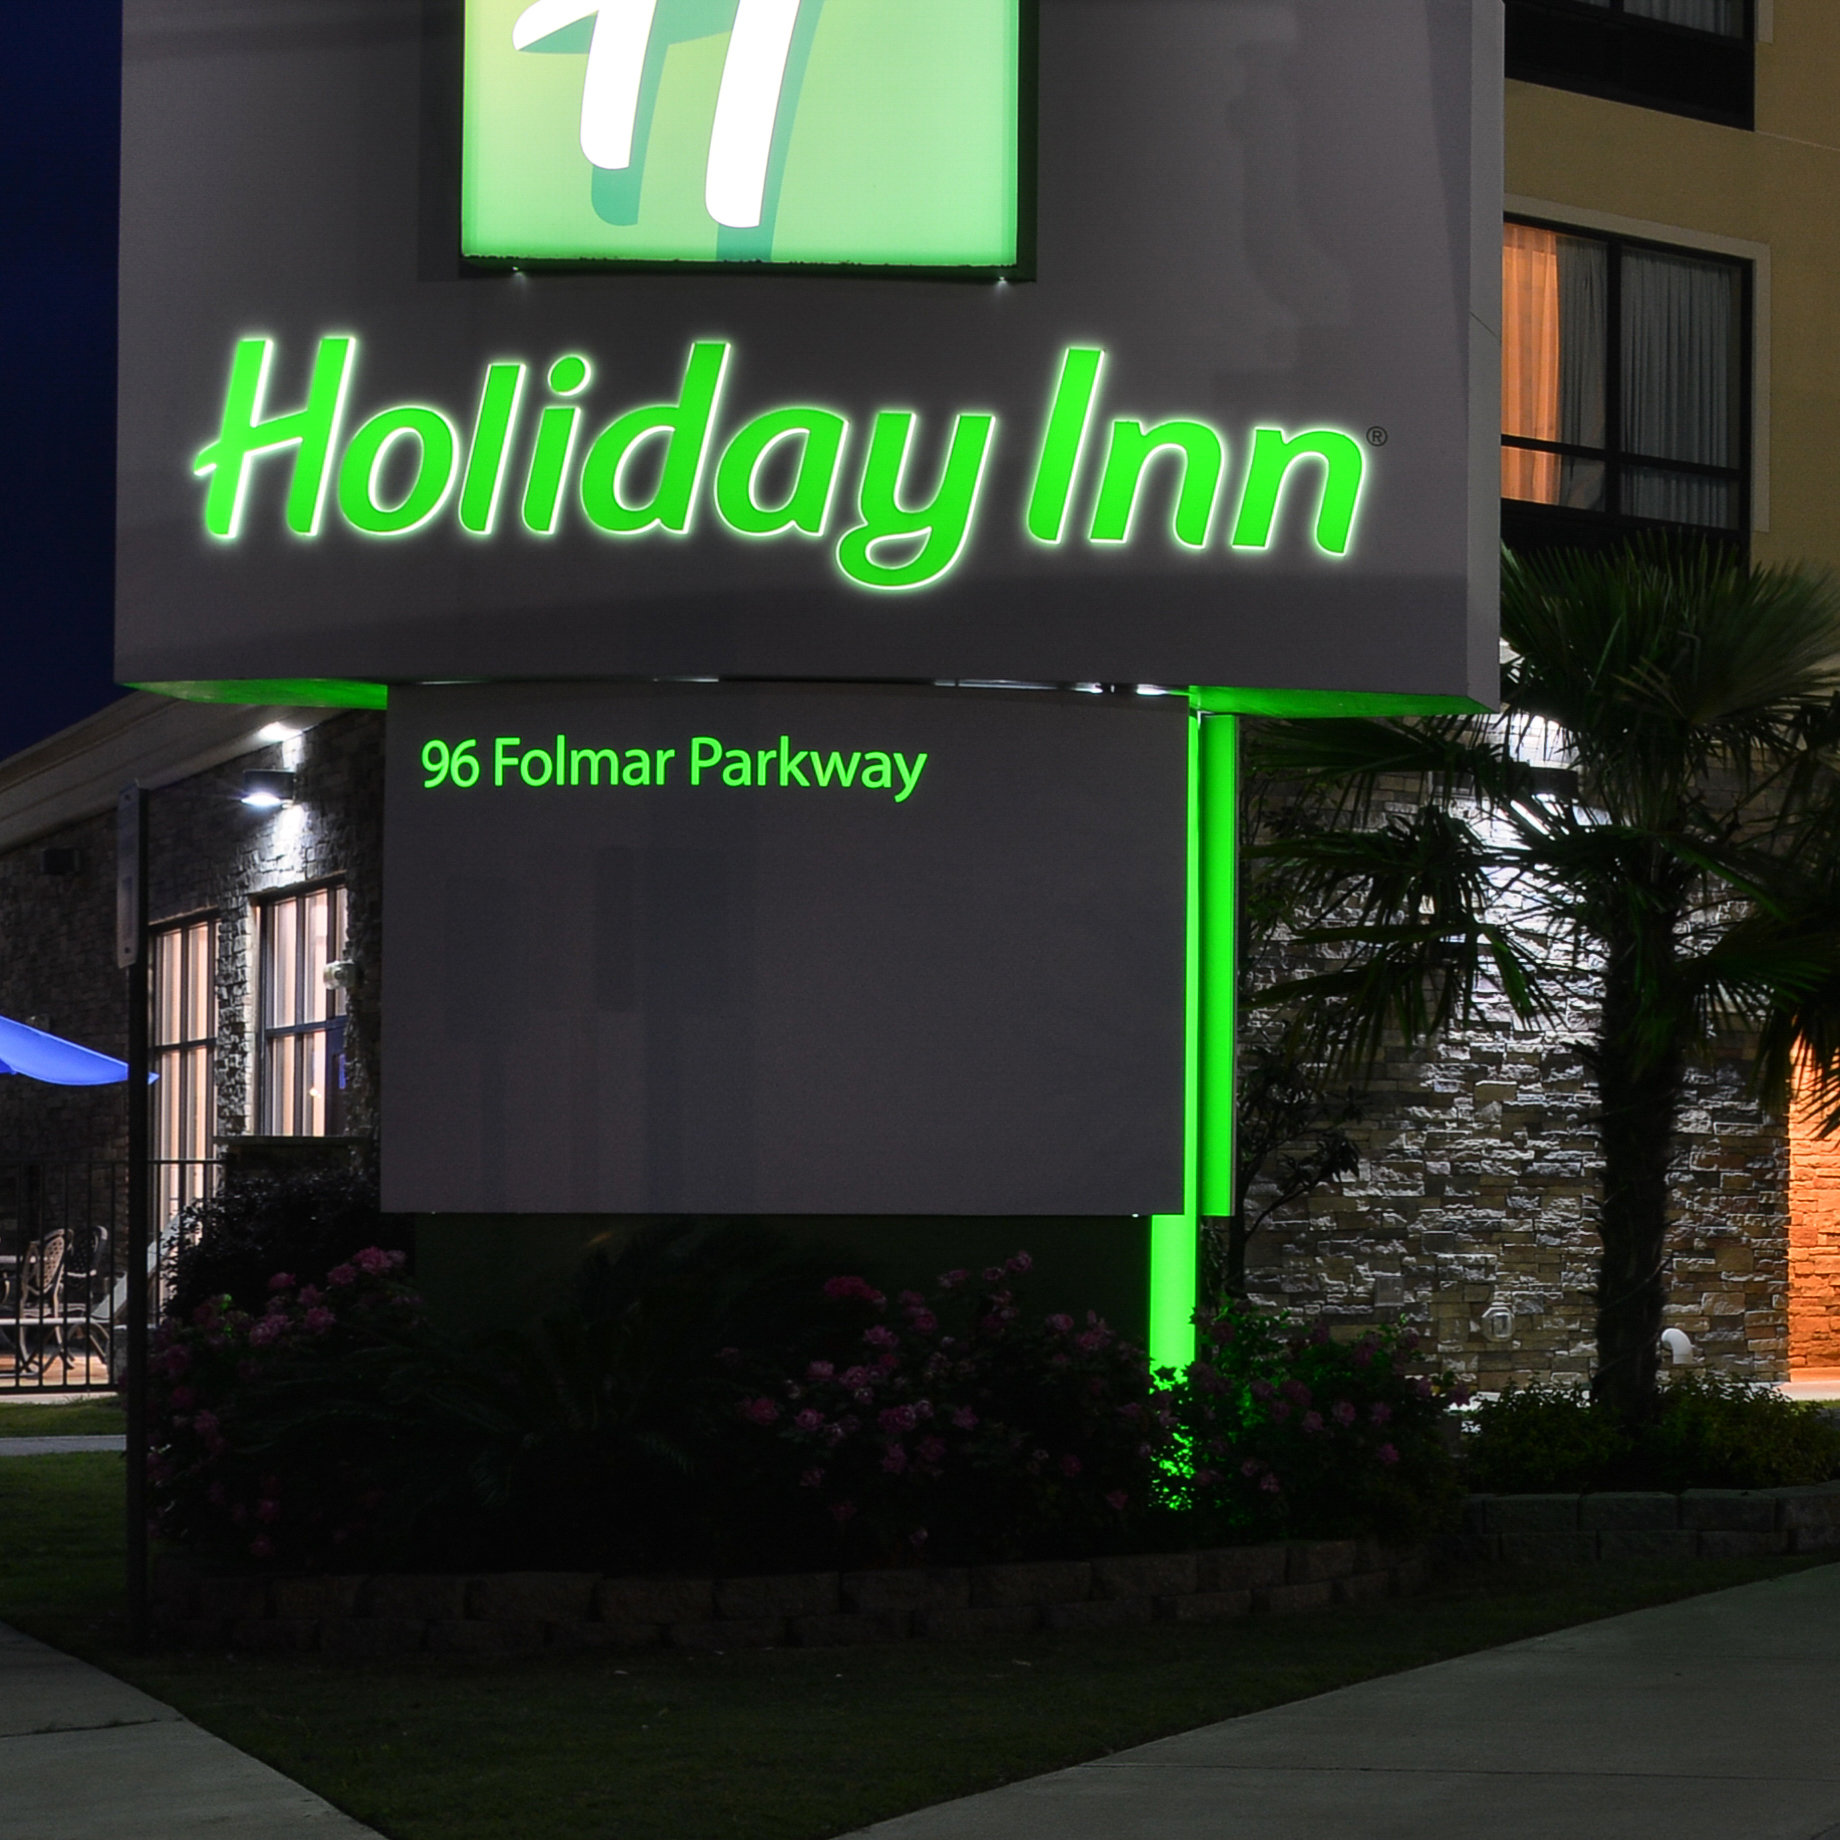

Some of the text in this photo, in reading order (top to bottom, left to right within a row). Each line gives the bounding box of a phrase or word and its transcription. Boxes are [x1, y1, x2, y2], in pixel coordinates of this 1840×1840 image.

[191, 335, 1369, 593] Holiday Inn
[421, 734, 928, 803] 96 Folmar Parkway
